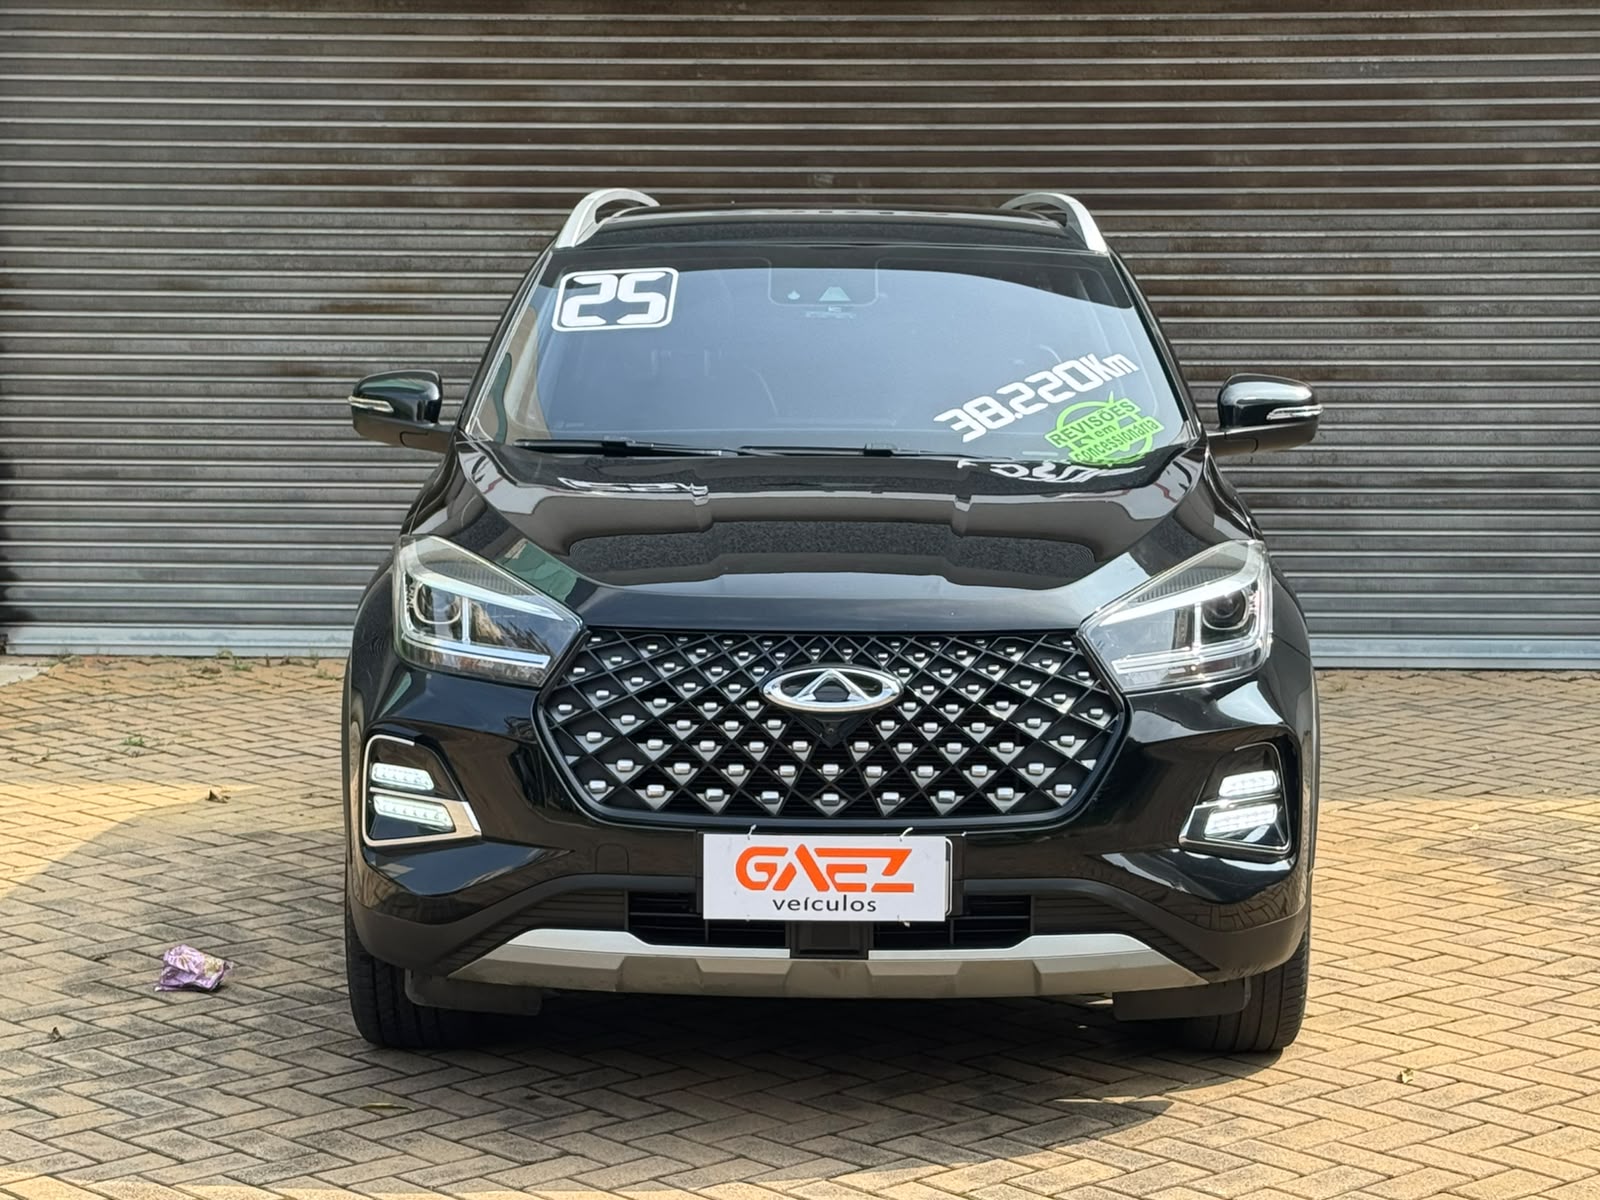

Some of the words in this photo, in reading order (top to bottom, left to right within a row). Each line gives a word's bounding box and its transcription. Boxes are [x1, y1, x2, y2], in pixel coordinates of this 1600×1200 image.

[561, 271, 667, 327] 25
[933, 353, 1140, 442] 38.220Km
[1048, 400, 1136, 446] REVISÕES
[1094, 423, 1118, 438] em
[735, 843, 915, 893] GAEZ
[772, 894, 878, 912] veículos
